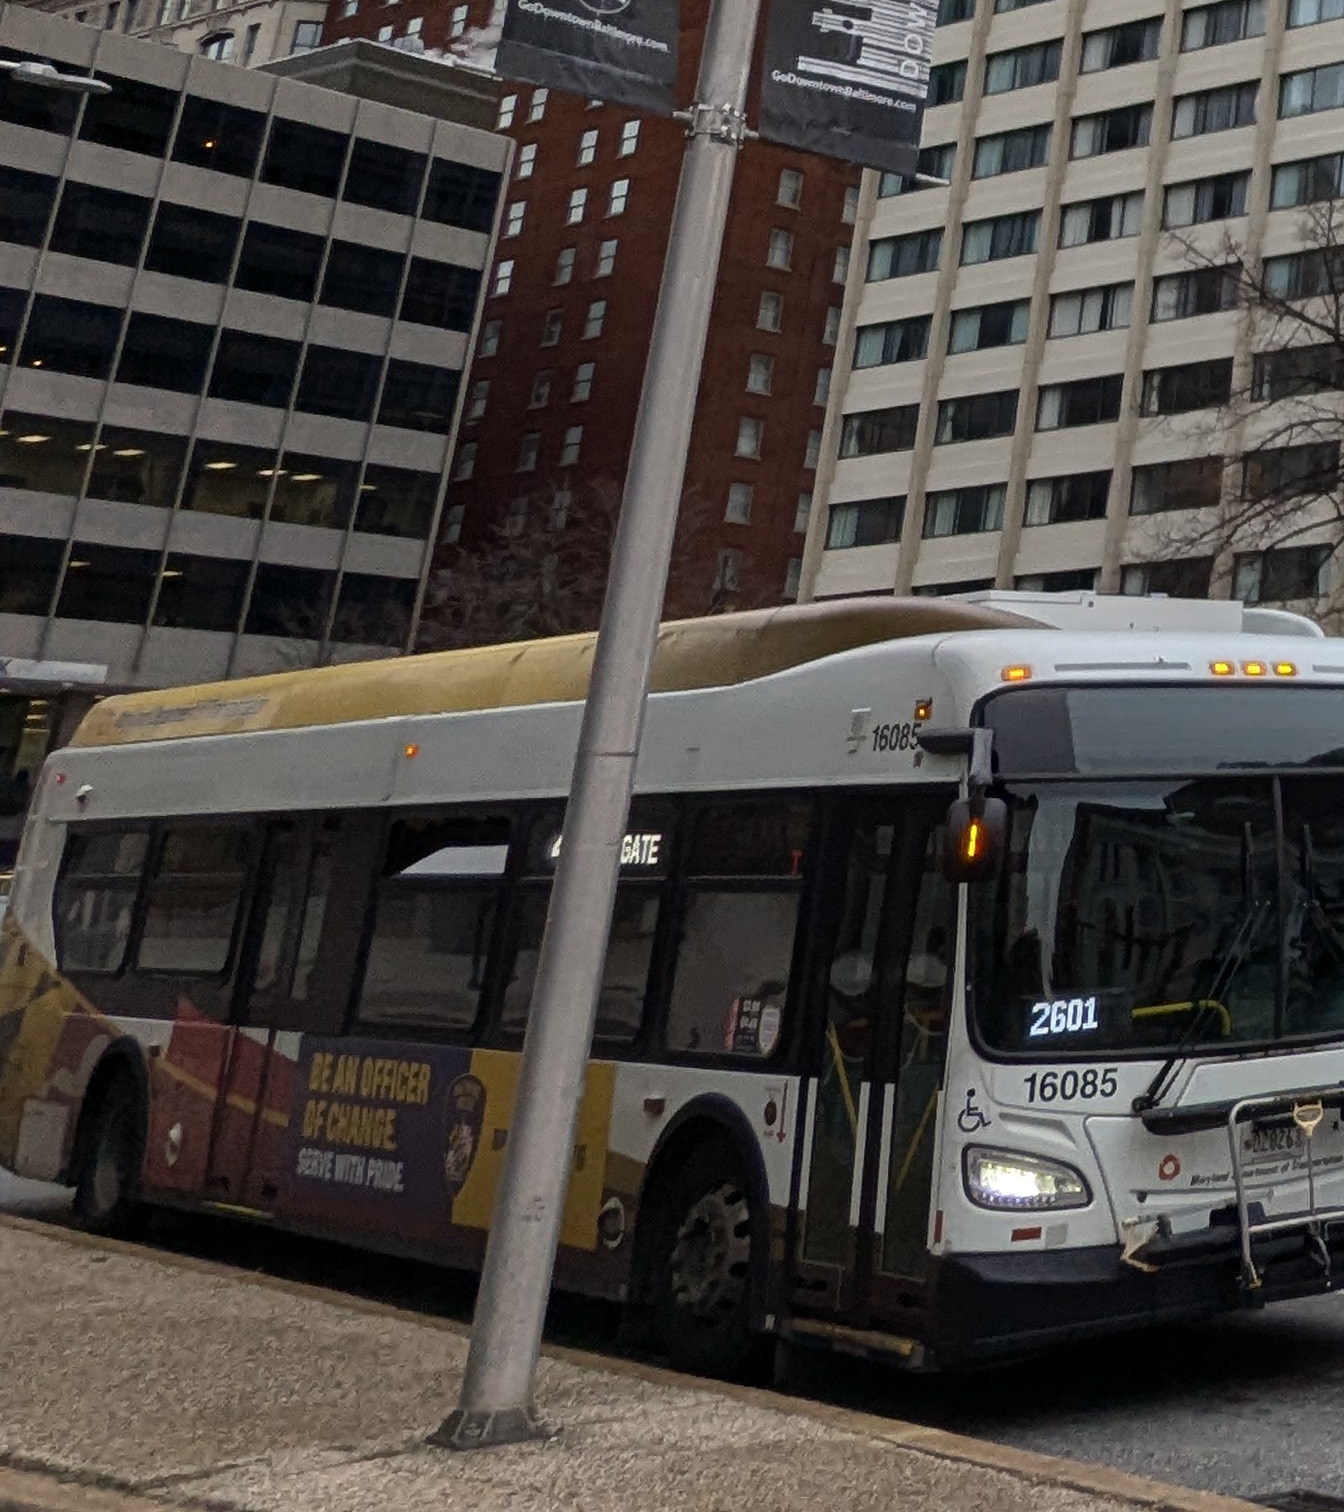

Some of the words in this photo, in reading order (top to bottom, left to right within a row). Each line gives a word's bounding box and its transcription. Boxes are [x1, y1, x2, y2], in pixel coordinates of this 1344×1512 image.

[872, 722, 922, 752] 16085
[1029, 996, 1099, 1037] 2601
[308, 1051, 334, 1093] BE
[332, 1054, 360, 1095] AN
[361, 1056, 432, 1106] OFFICER
[1023, 1067, 1119, 1103] 16085
[302, 1098, 328, 1141] OF
[297, 1147, 335, 1181] SERVE
[334, 1154, 366, 1185] WITH
